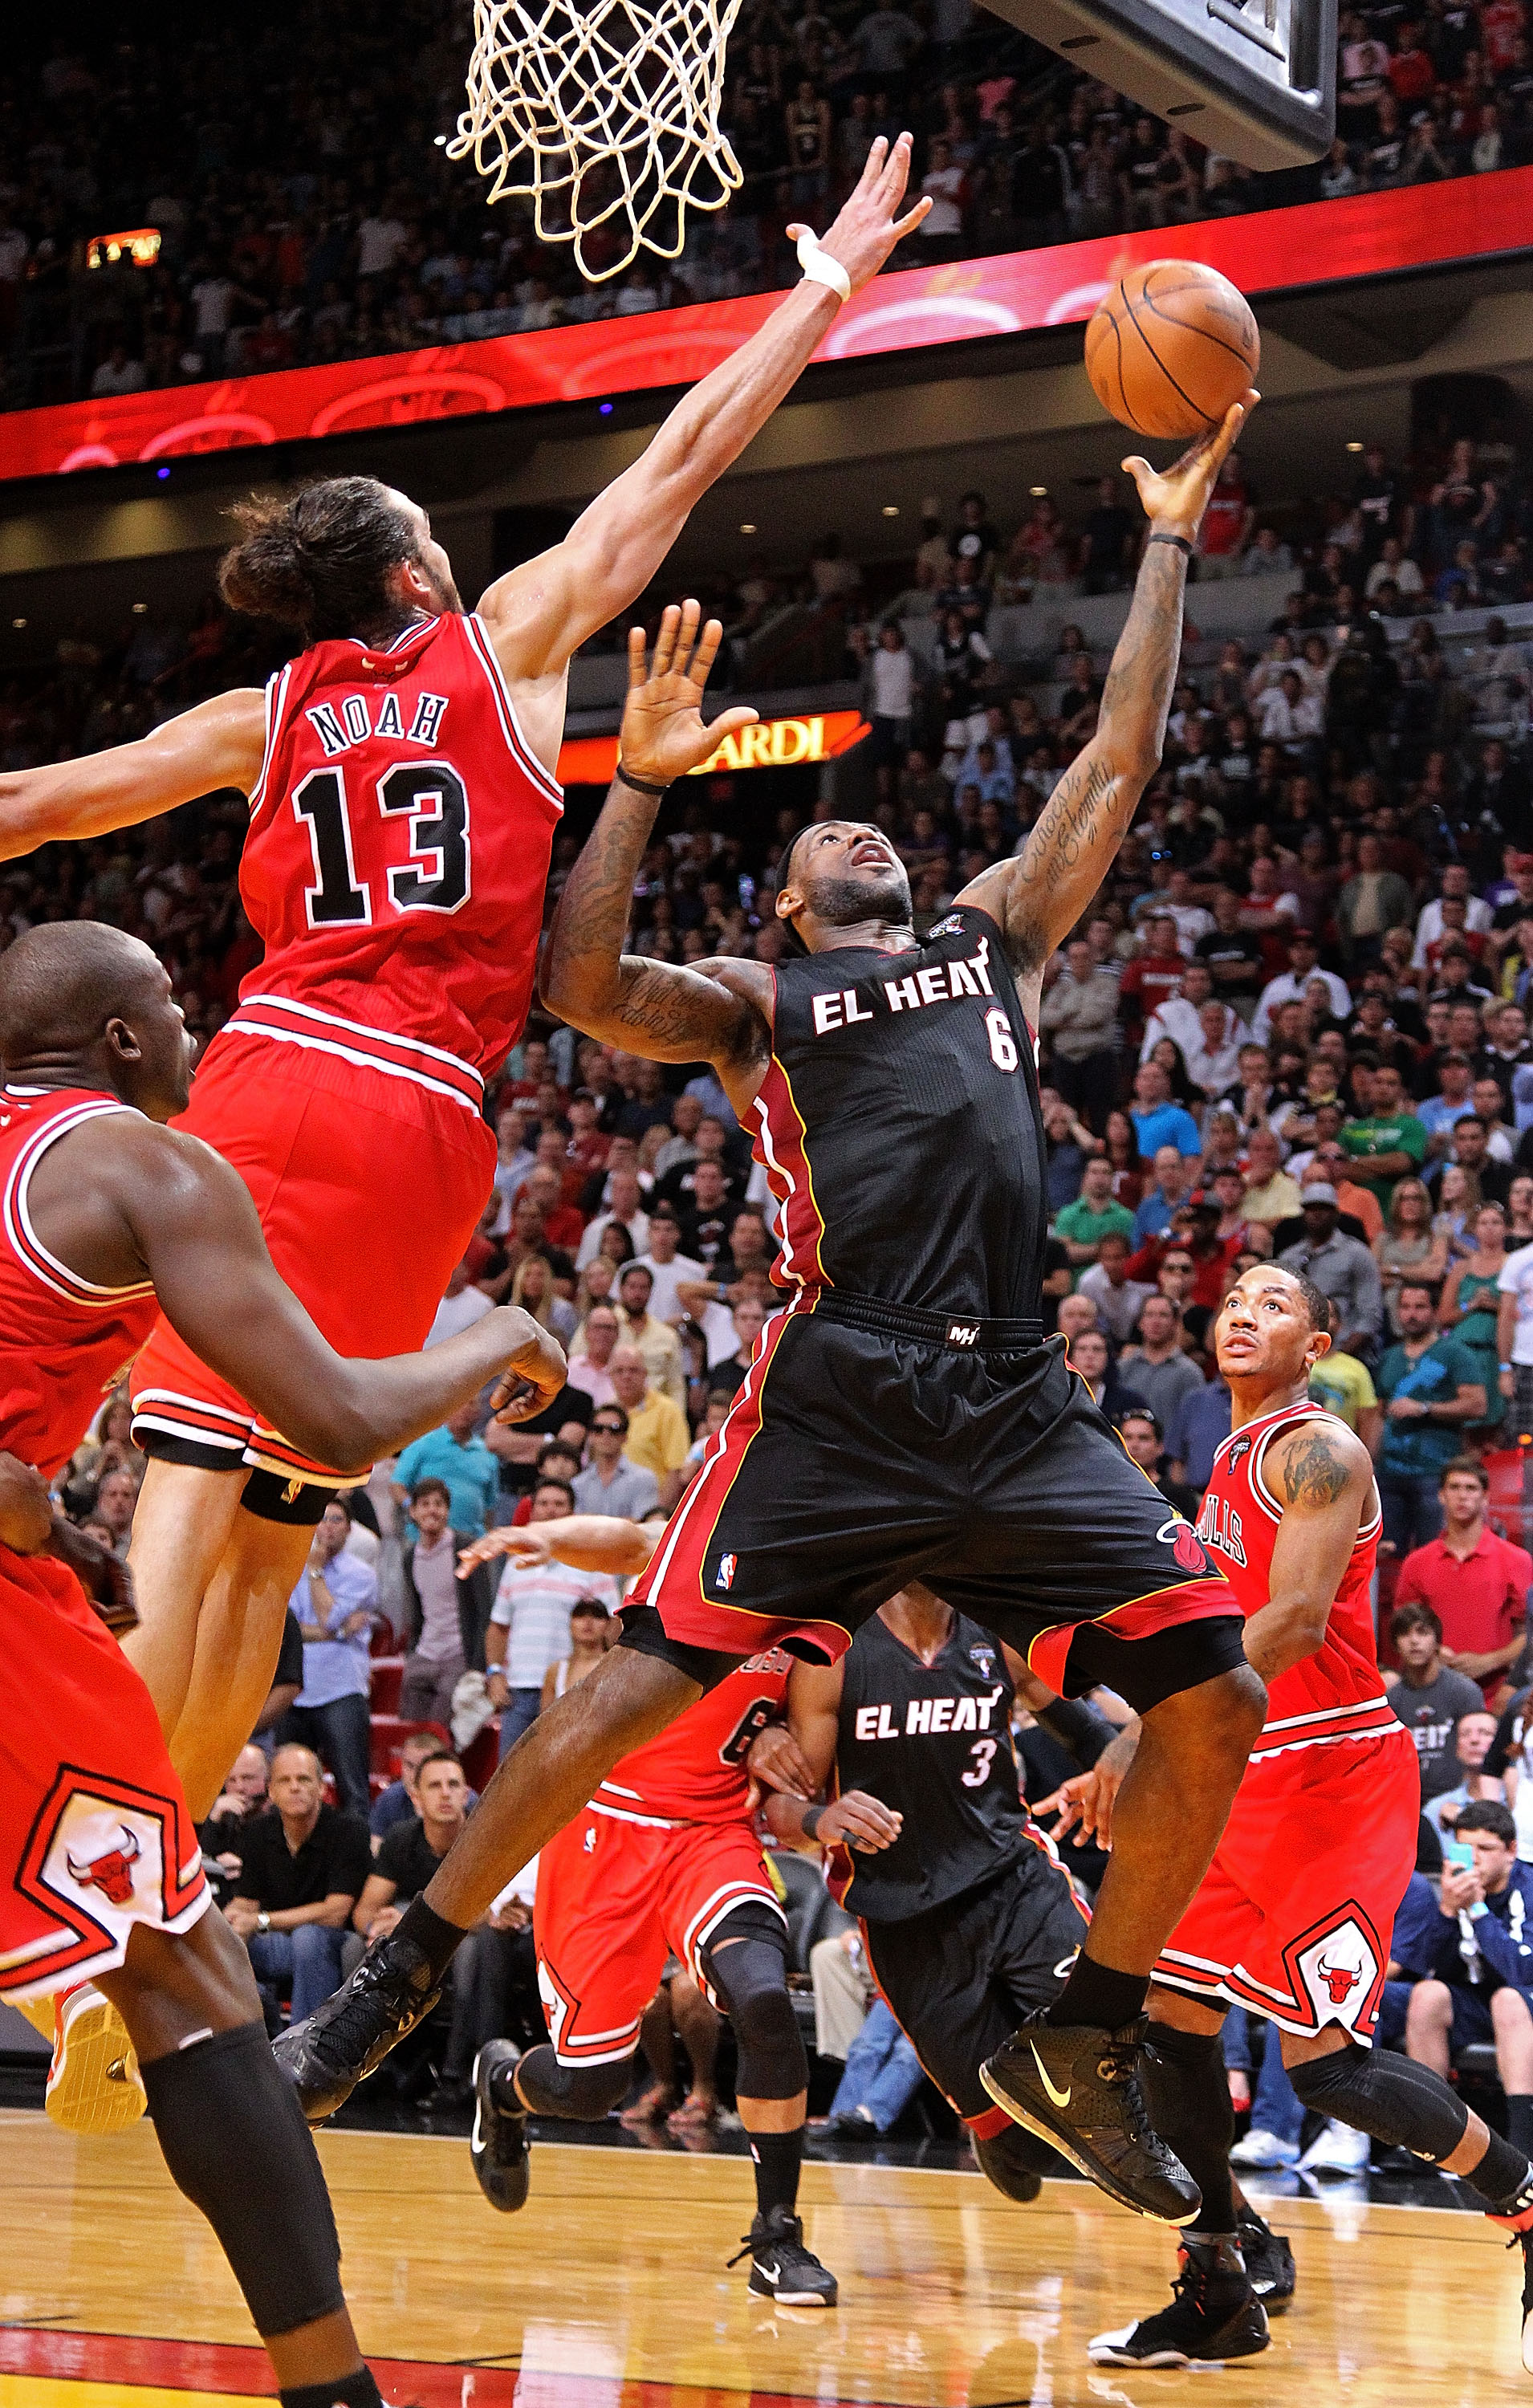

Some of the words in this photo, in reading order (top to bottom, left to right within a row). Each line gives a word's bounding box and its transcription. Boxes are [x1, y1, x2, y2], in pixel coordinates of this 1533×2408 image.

[305, 692, 449, 758] NOAH
[686, 717, 824, 775] ARDI
[291, 759, 472, 930] 13
[811, 987, 874, 1037] EL
[883, 934, 995, 1013] HEAT
[984, 1007, 1020, 1074] 6
[1194, 1493, 1247, 1568] ULLS
[855, 1703, 900, 1741] EL
[905, 1684, 1004, 1736] HEAT
[960, 1738, 998, 1788] 3
